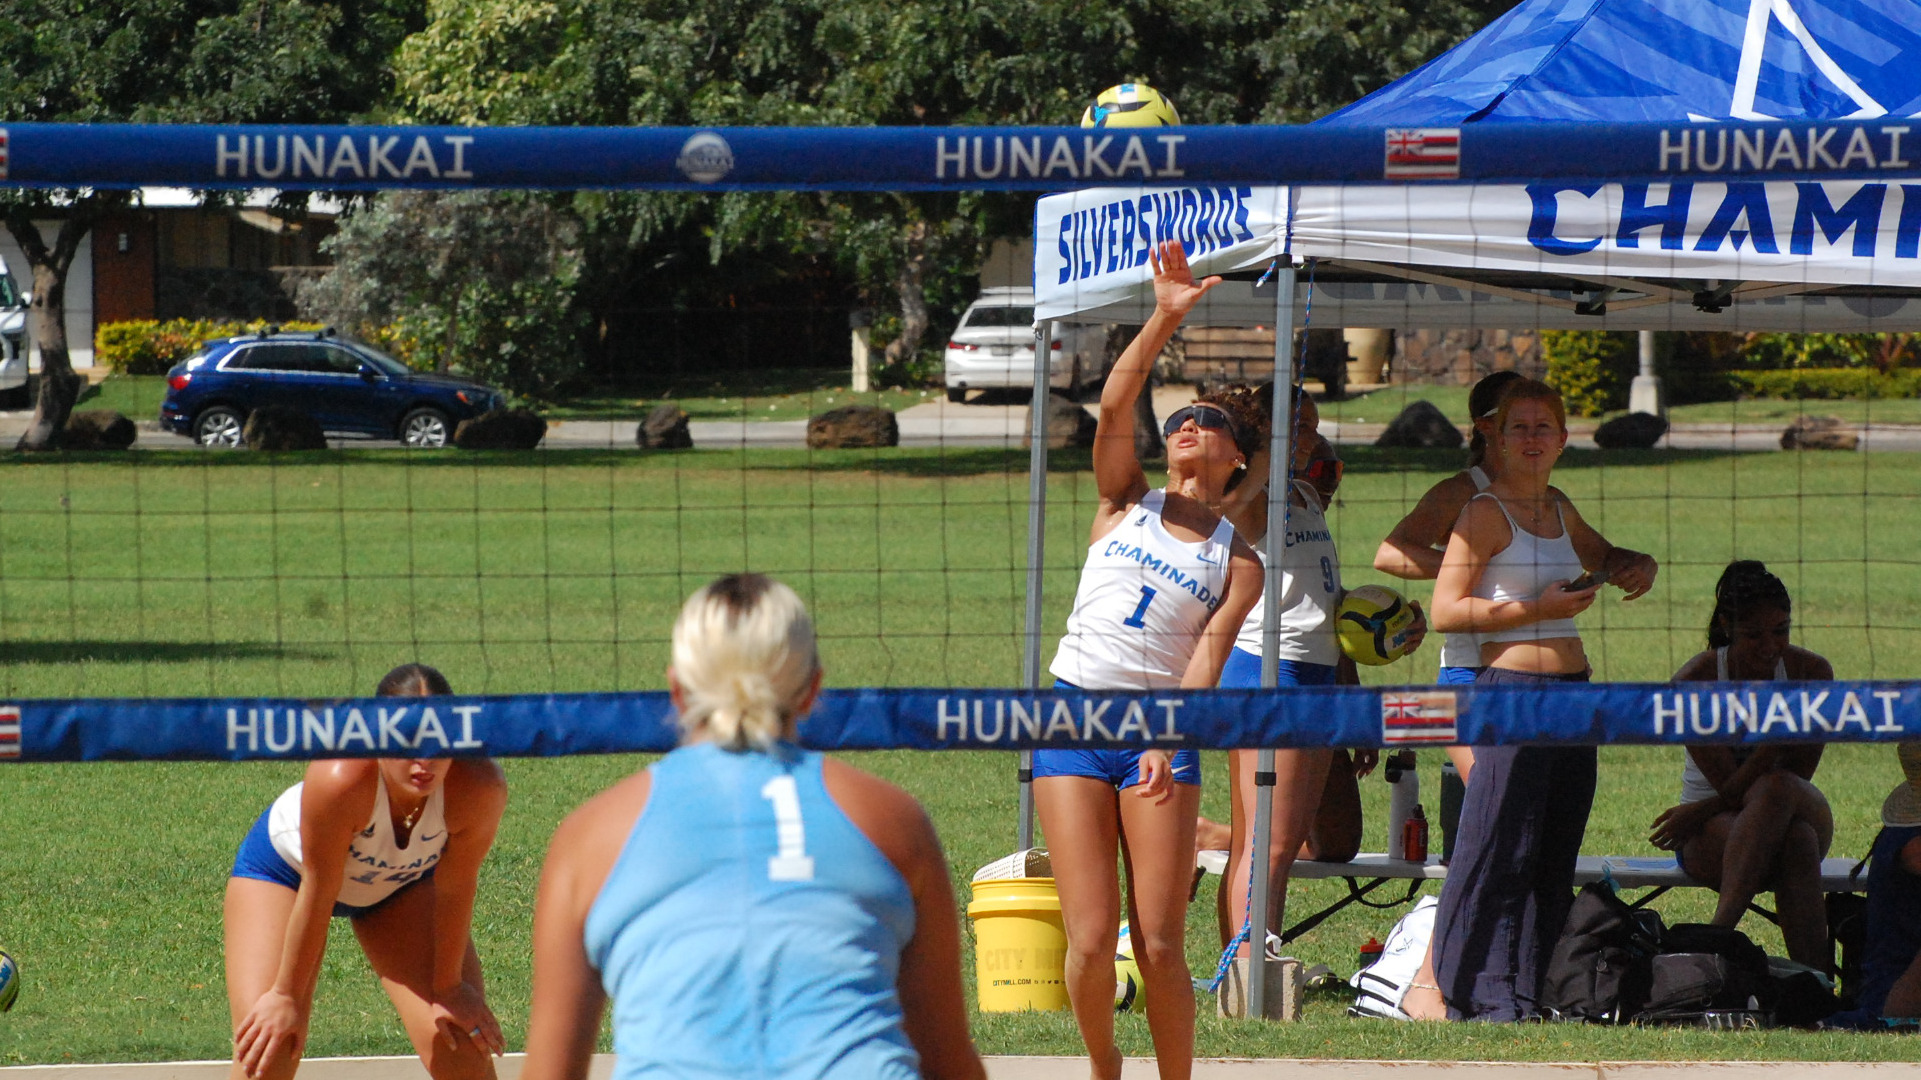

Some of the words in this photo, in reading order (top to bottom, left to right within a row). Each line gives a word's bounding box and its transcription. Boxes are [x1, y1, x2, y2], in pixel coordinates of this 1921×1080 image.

[216, 135, 474, 179] HUNAKAI
[935, 134, 1187, 179] HUNAKAI
[1658, 126, 1910, 172] HUNAKAI
[1058, 186, 1254, 285] SILVERSWORDS
[1104, 540, 1219, 611] CHAMINADE
[1320, 555, 1335, 593] 9
[1122, 584, 1158, 629] 1
[226, 705, 483, 752] HUNAKAI
[937, 698, 1185, 742] HUNAKAI
[1652, 690, 1904, 736] HUNAKAI
[761, 774, 815, 882] 1
[984, 947, 1027, 972] CITY
